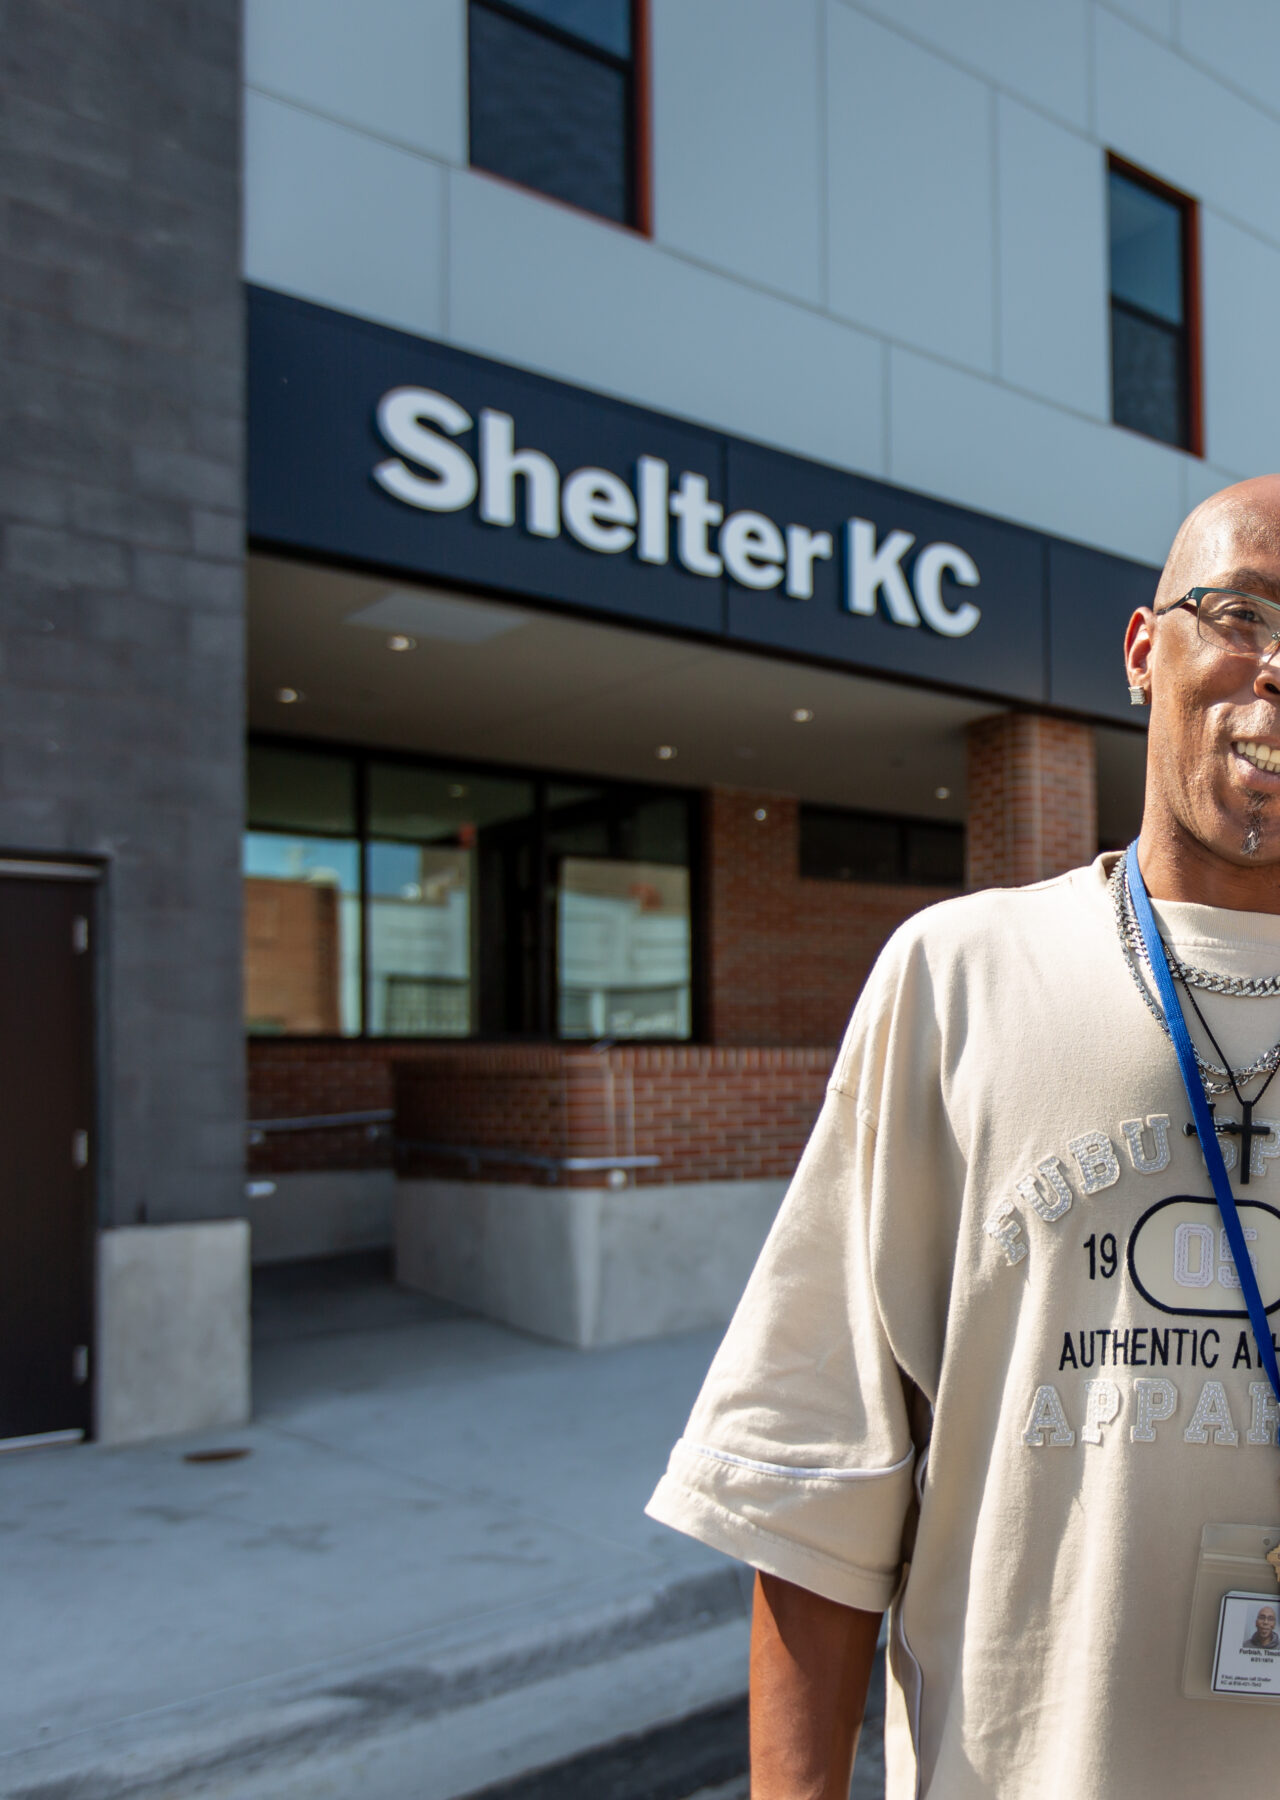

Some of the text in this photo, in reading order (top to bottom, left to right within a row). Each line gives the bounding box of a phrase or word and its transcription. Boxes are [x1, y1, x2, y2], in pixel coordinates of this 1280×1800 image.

[373, 385, 981, 637] Shelter KC
[983, 1113, 1172, 1267] FUBU
[1083, 1232, 1118, 1280] 19
[1058, 1327, 1220, 1372] AUTHENTIC
